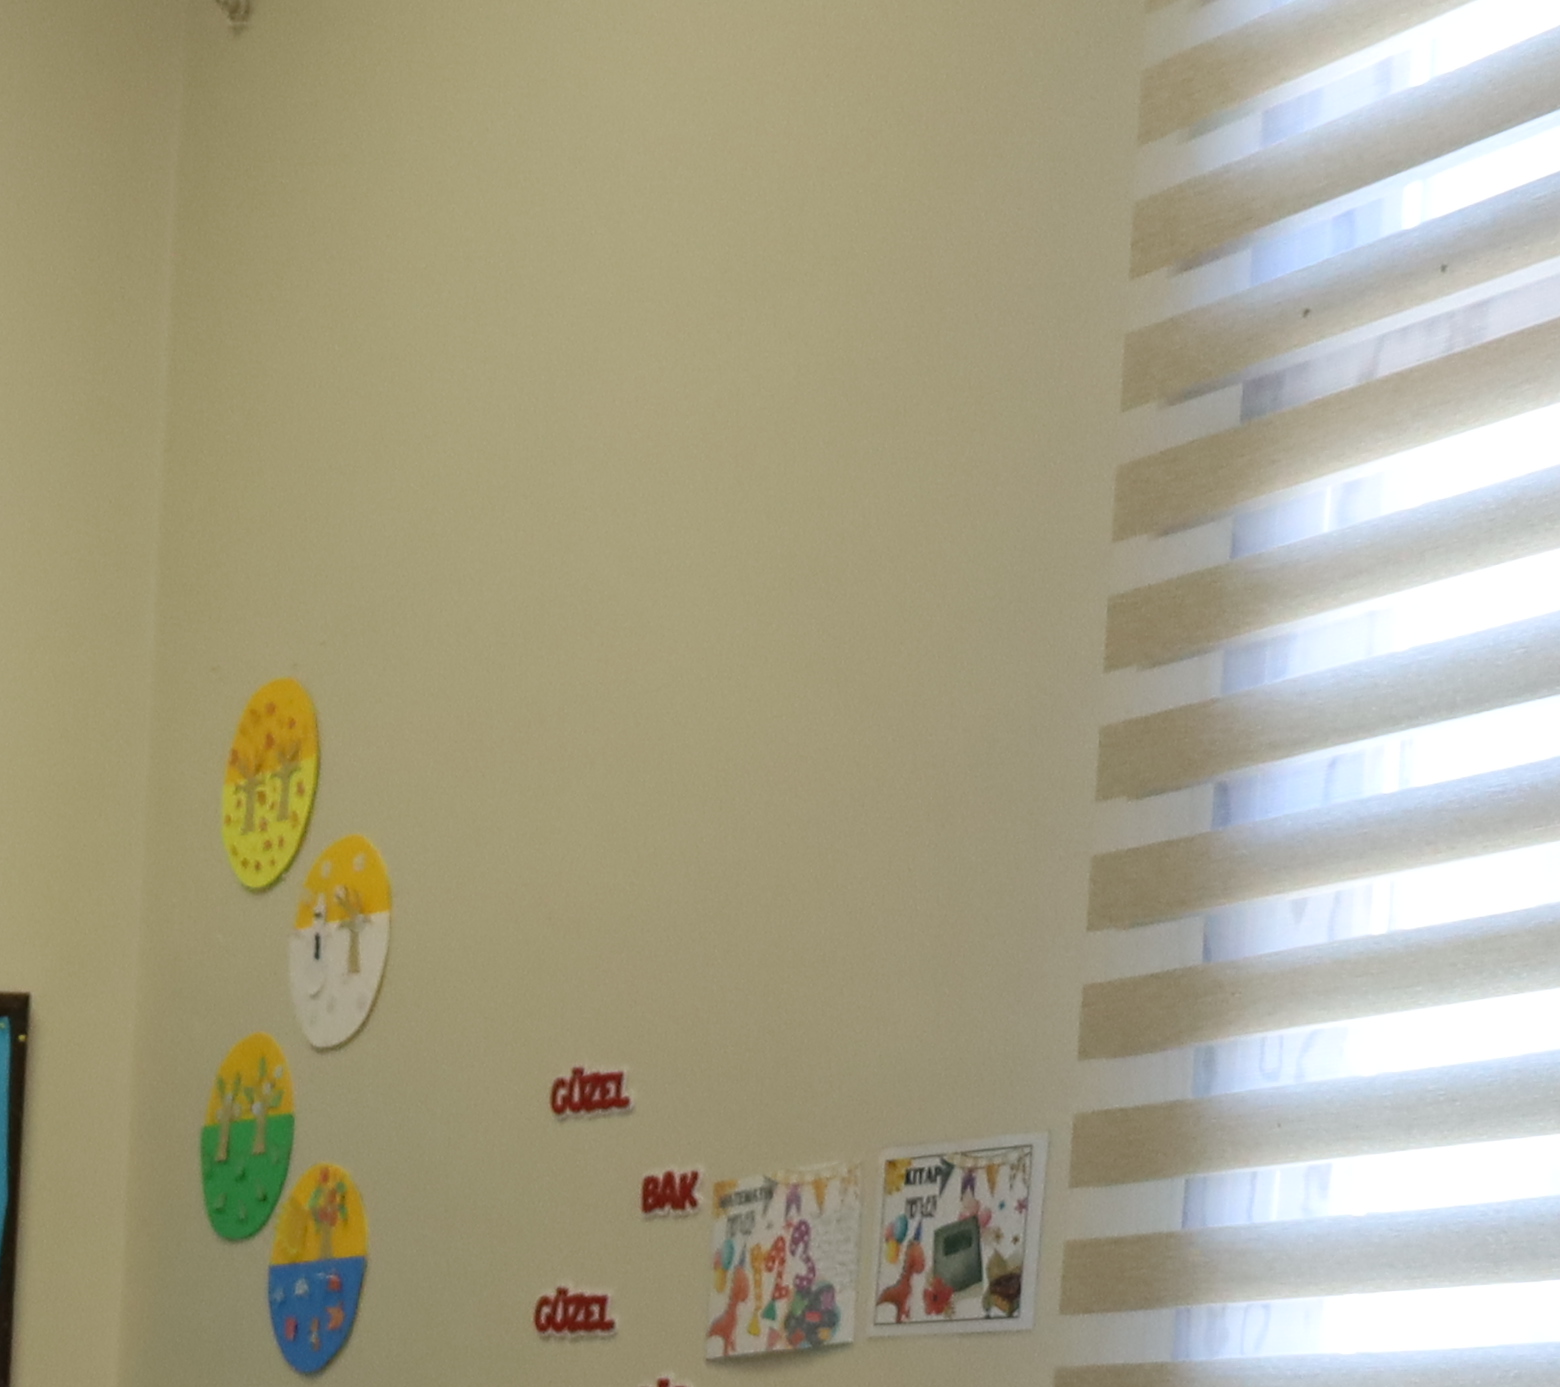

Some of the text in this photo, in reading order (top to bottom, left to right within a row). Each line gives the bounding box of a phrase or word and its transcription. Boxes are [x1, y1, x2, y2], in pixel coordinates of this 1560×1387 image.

[550, 1067, 631, 1115] GÜZEL
[641, 1170, 698, 1213] BAK
[535, 1286, 615, 1333] GÜZEL
